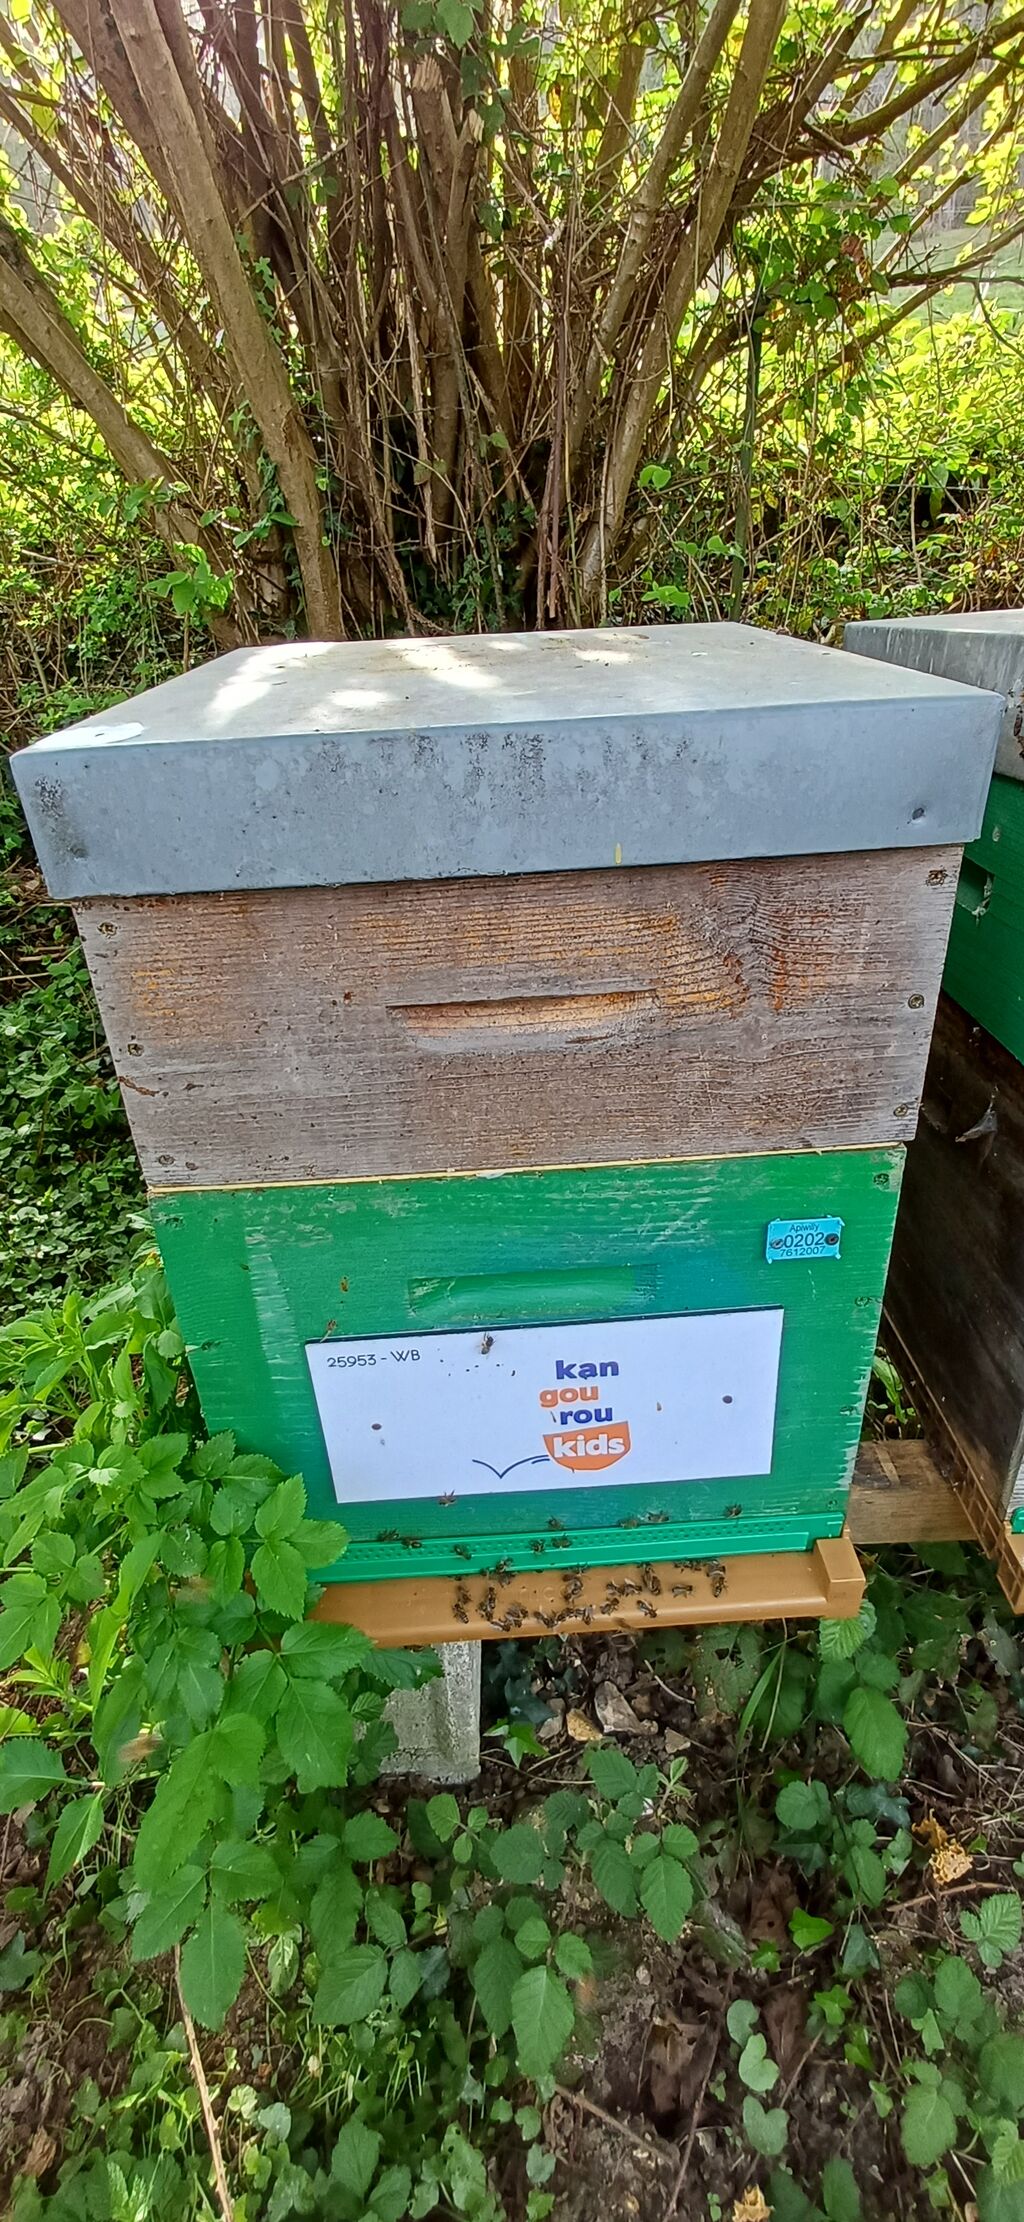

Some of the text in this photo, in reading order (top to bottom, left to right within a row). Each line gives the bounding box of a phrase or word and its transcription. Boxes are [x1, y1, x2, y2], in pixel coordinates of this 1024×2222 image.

[784, 1232, 825, 1248] 0202
[780, 1246, 825, 1257] 7612007
[327, 1354, 377, 1368] 25953
[390, 1349, 421, 1362] WB
[555, 1360, 619, 1380] kan
[539, 1386, 600, 1408] gou
[560, 1407, 613, 1425] rou
[553, 1433, 626, 1458] kids
